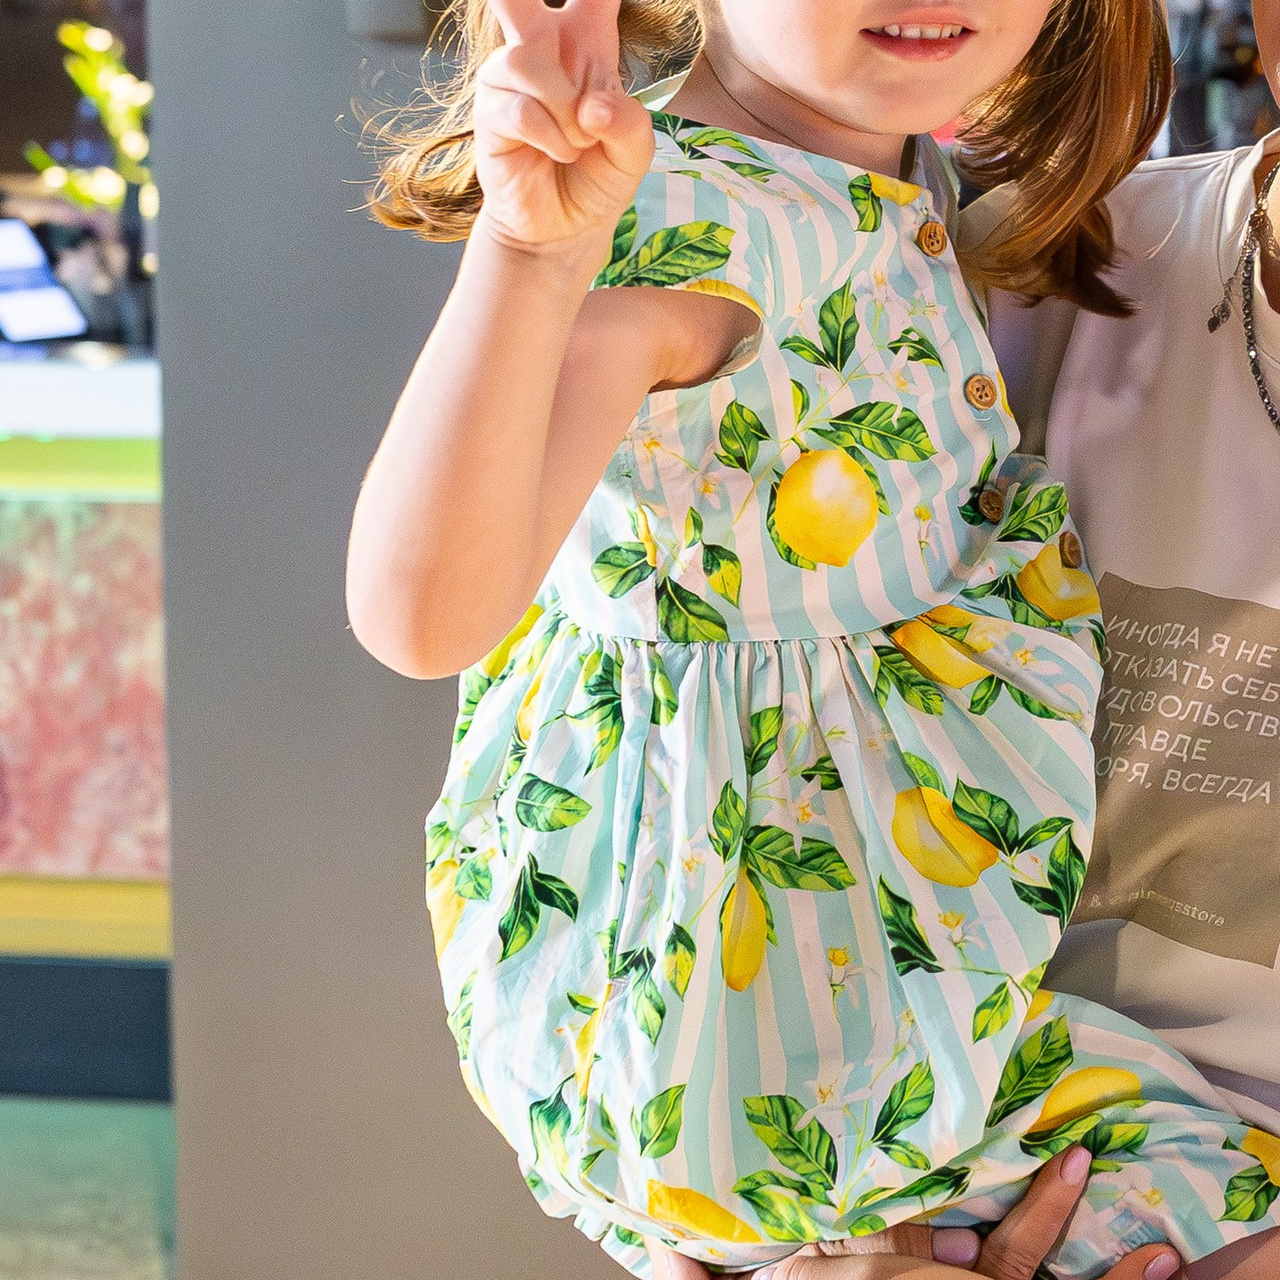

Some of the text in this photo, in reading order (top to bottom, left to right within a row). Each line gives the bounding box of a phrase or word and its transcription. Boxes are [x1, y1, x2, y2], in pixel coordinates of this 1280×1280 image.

[1106, 614, 1199, 650] ИНОГДА
[1206, 632, 1231, 658] Я
[1235, 640, 1279, 668] НЕ
[1096, 757, 1271, 805] ОРЯ, ВСЕГДА
